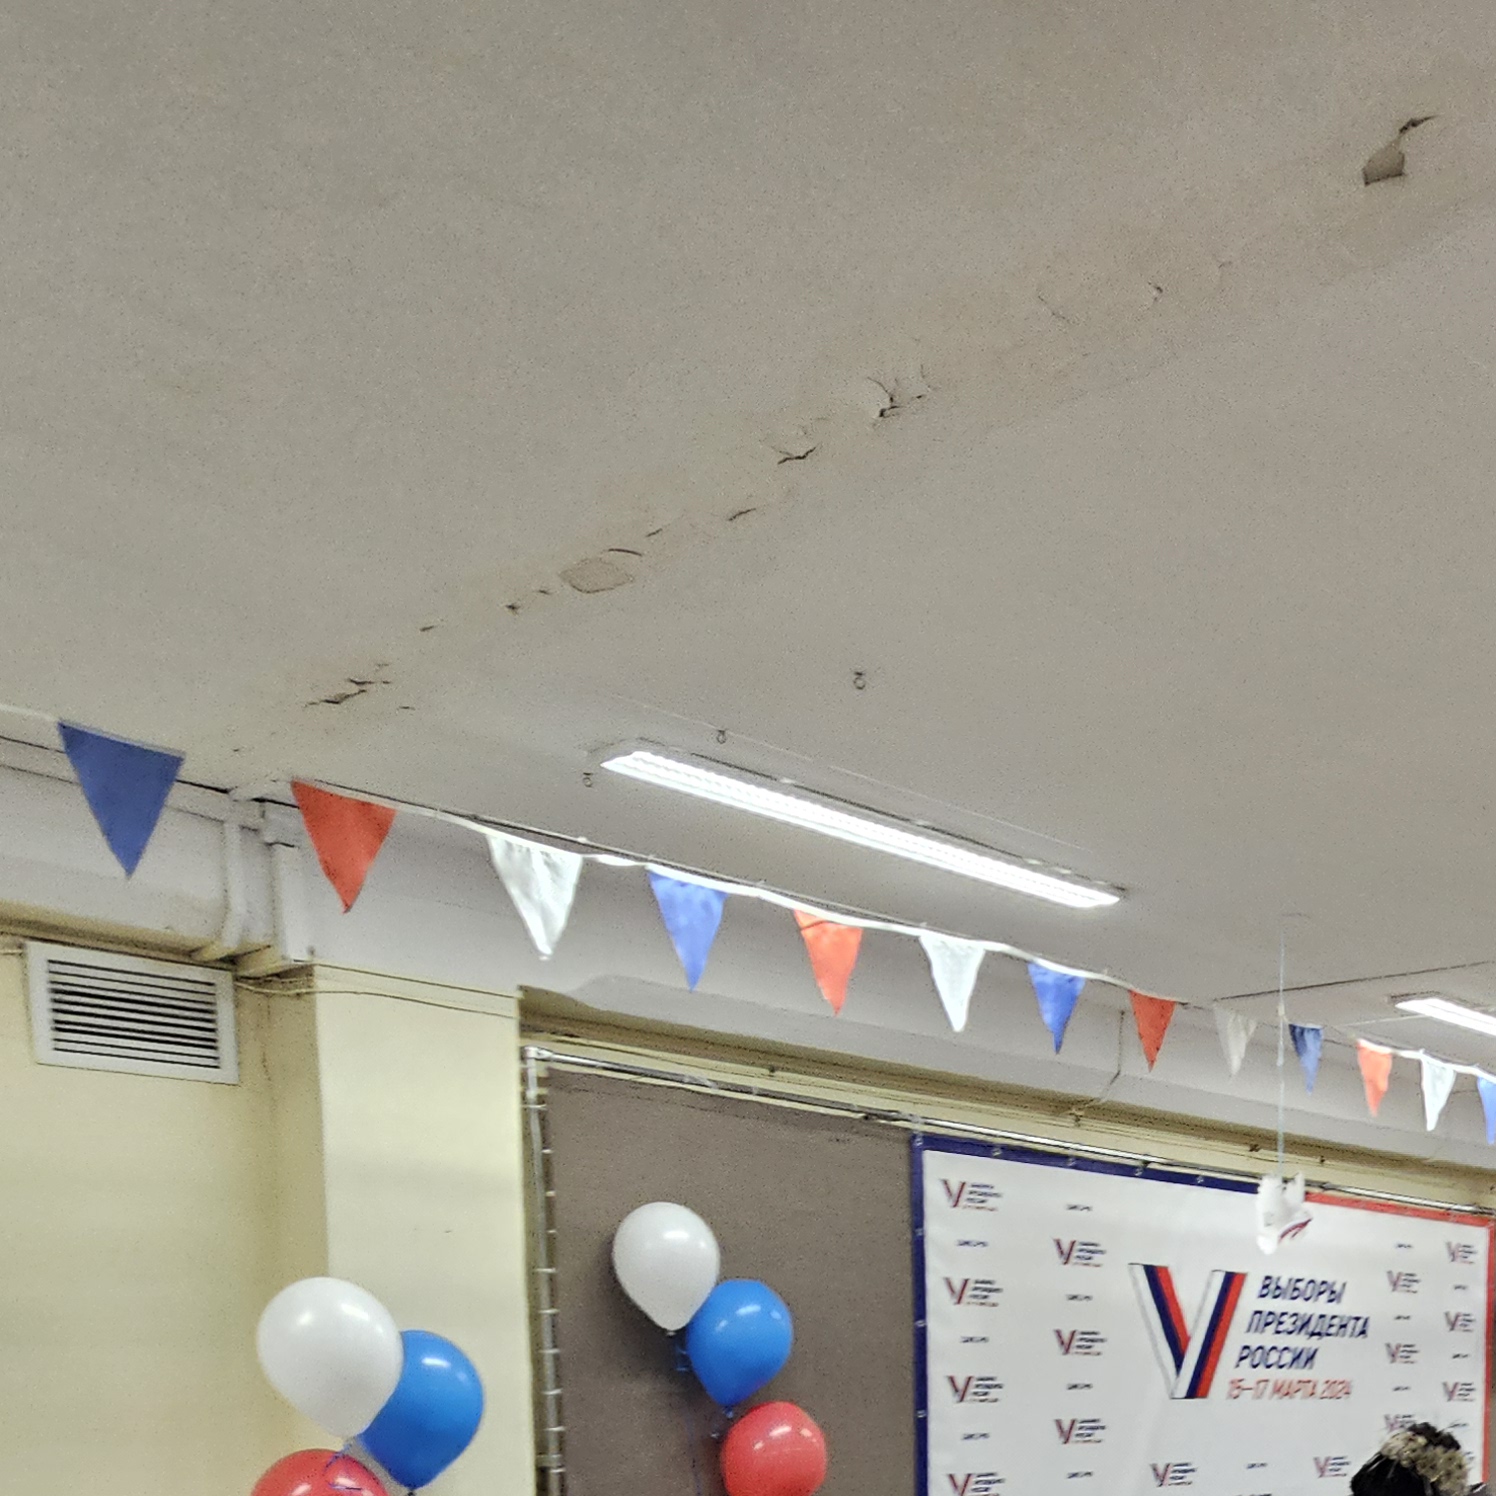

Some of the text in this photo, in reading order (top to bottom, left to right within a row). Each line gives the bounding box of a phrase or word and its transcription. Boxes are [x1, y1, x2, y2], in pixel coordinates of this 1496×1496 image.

[1257, 1275, 1347, 1304] ВЫБОРЫ
[1127, 1263, 1248, 1400] V
[1245, 1310, 1371, 1340] ПРЕЗИДЕНТА
[1234, 1344, 1320, 1370] РОССИИ
[1271, 1378, 1319, 1400] МАРТА
[1319, 1379, 1353, 1400] 2024
